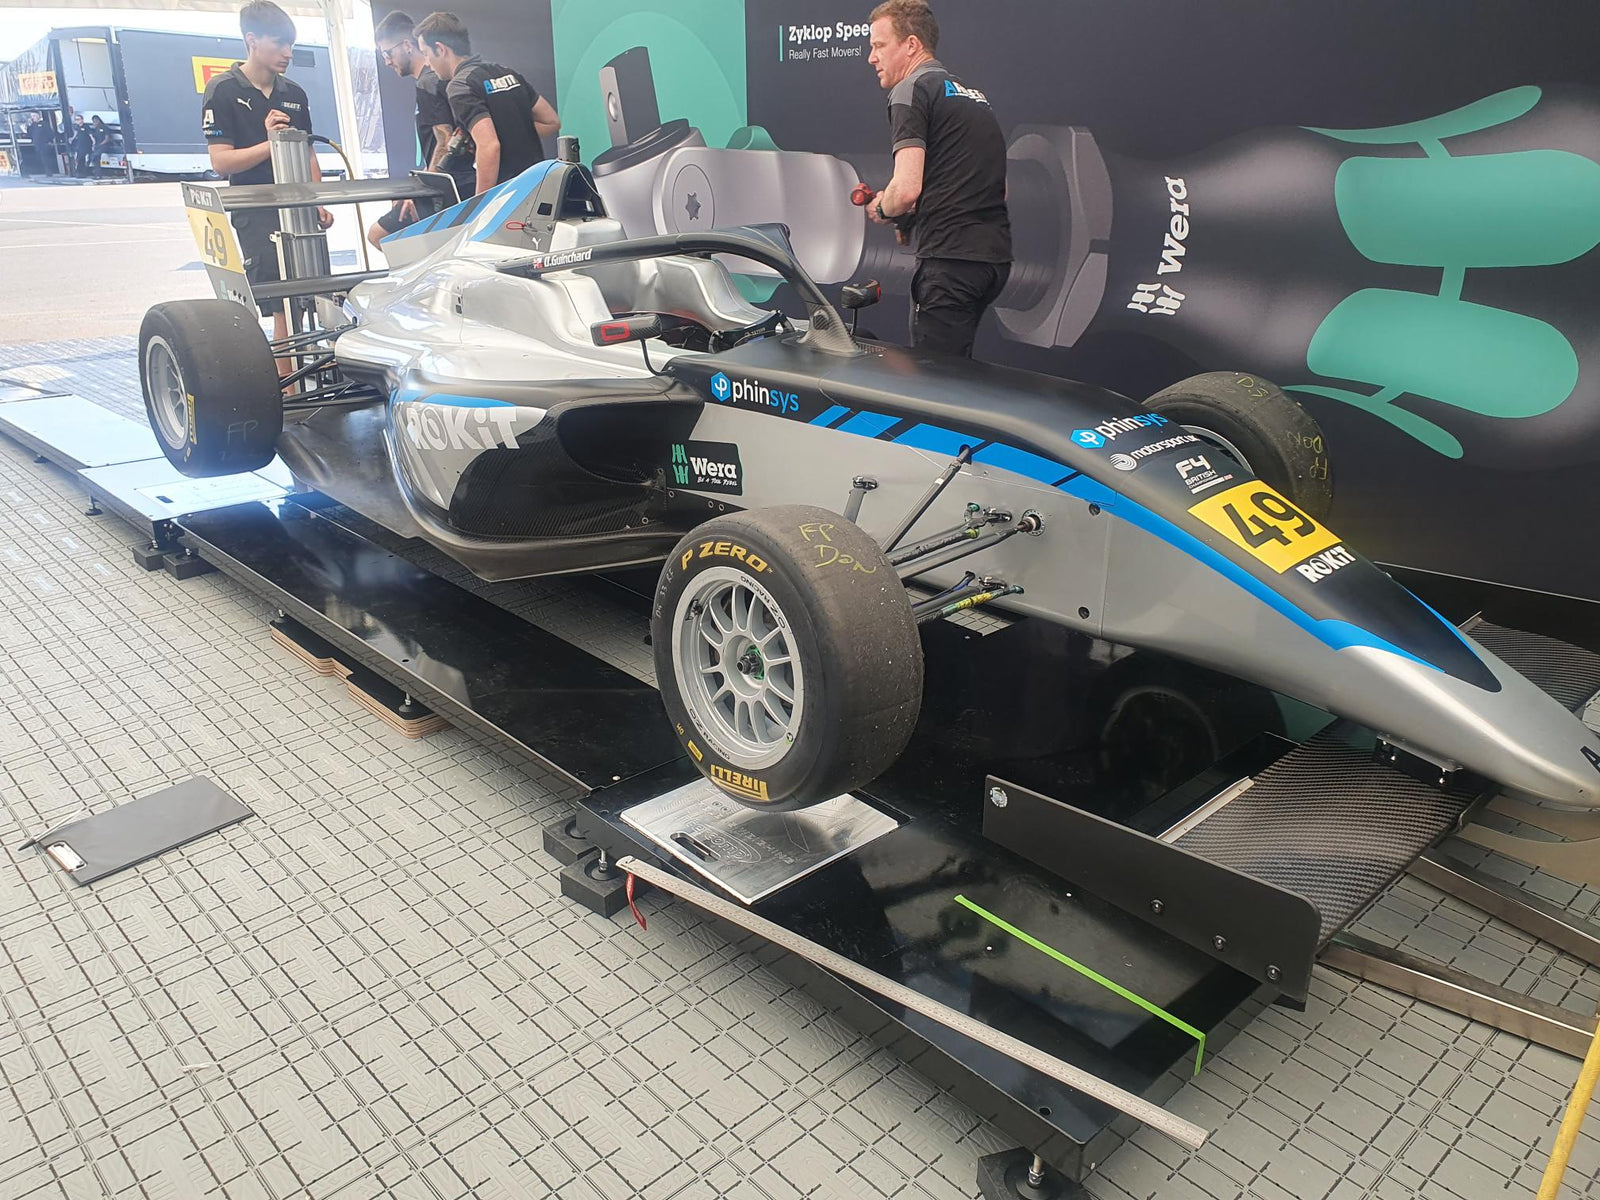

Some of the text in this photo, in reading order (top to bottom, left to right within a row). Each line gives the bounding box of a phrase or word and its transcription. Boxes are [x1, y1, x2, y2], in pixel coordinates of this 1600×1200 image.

[789, 22, 870, 44] Zyklop Spee
[789, 46, 861, 61] Really Fast Movers!
[1156, 176, 1190, 275] Wera
[204, 226, 228, 266] 49
[733, 379, 800, 414] phinsys
[1095, 412, 1169, 441] phinsys
[1131, 436, 1189, 460] motorsport
[690, 457, 737, 479] Wera
[1175, 455, 1212, 479] F4
[1185, 469, 1217, 486] BRITISH
[1222, 491, 1316, 549] 49
[681, 541, 768, 572] P ZERO
[1295, 545, 1357, 583] ROKiT
[740, 575, 769, 605] RACING
[703, 732, 731, 760] RACING
[710, 764, 770, 802] PIRELLI
